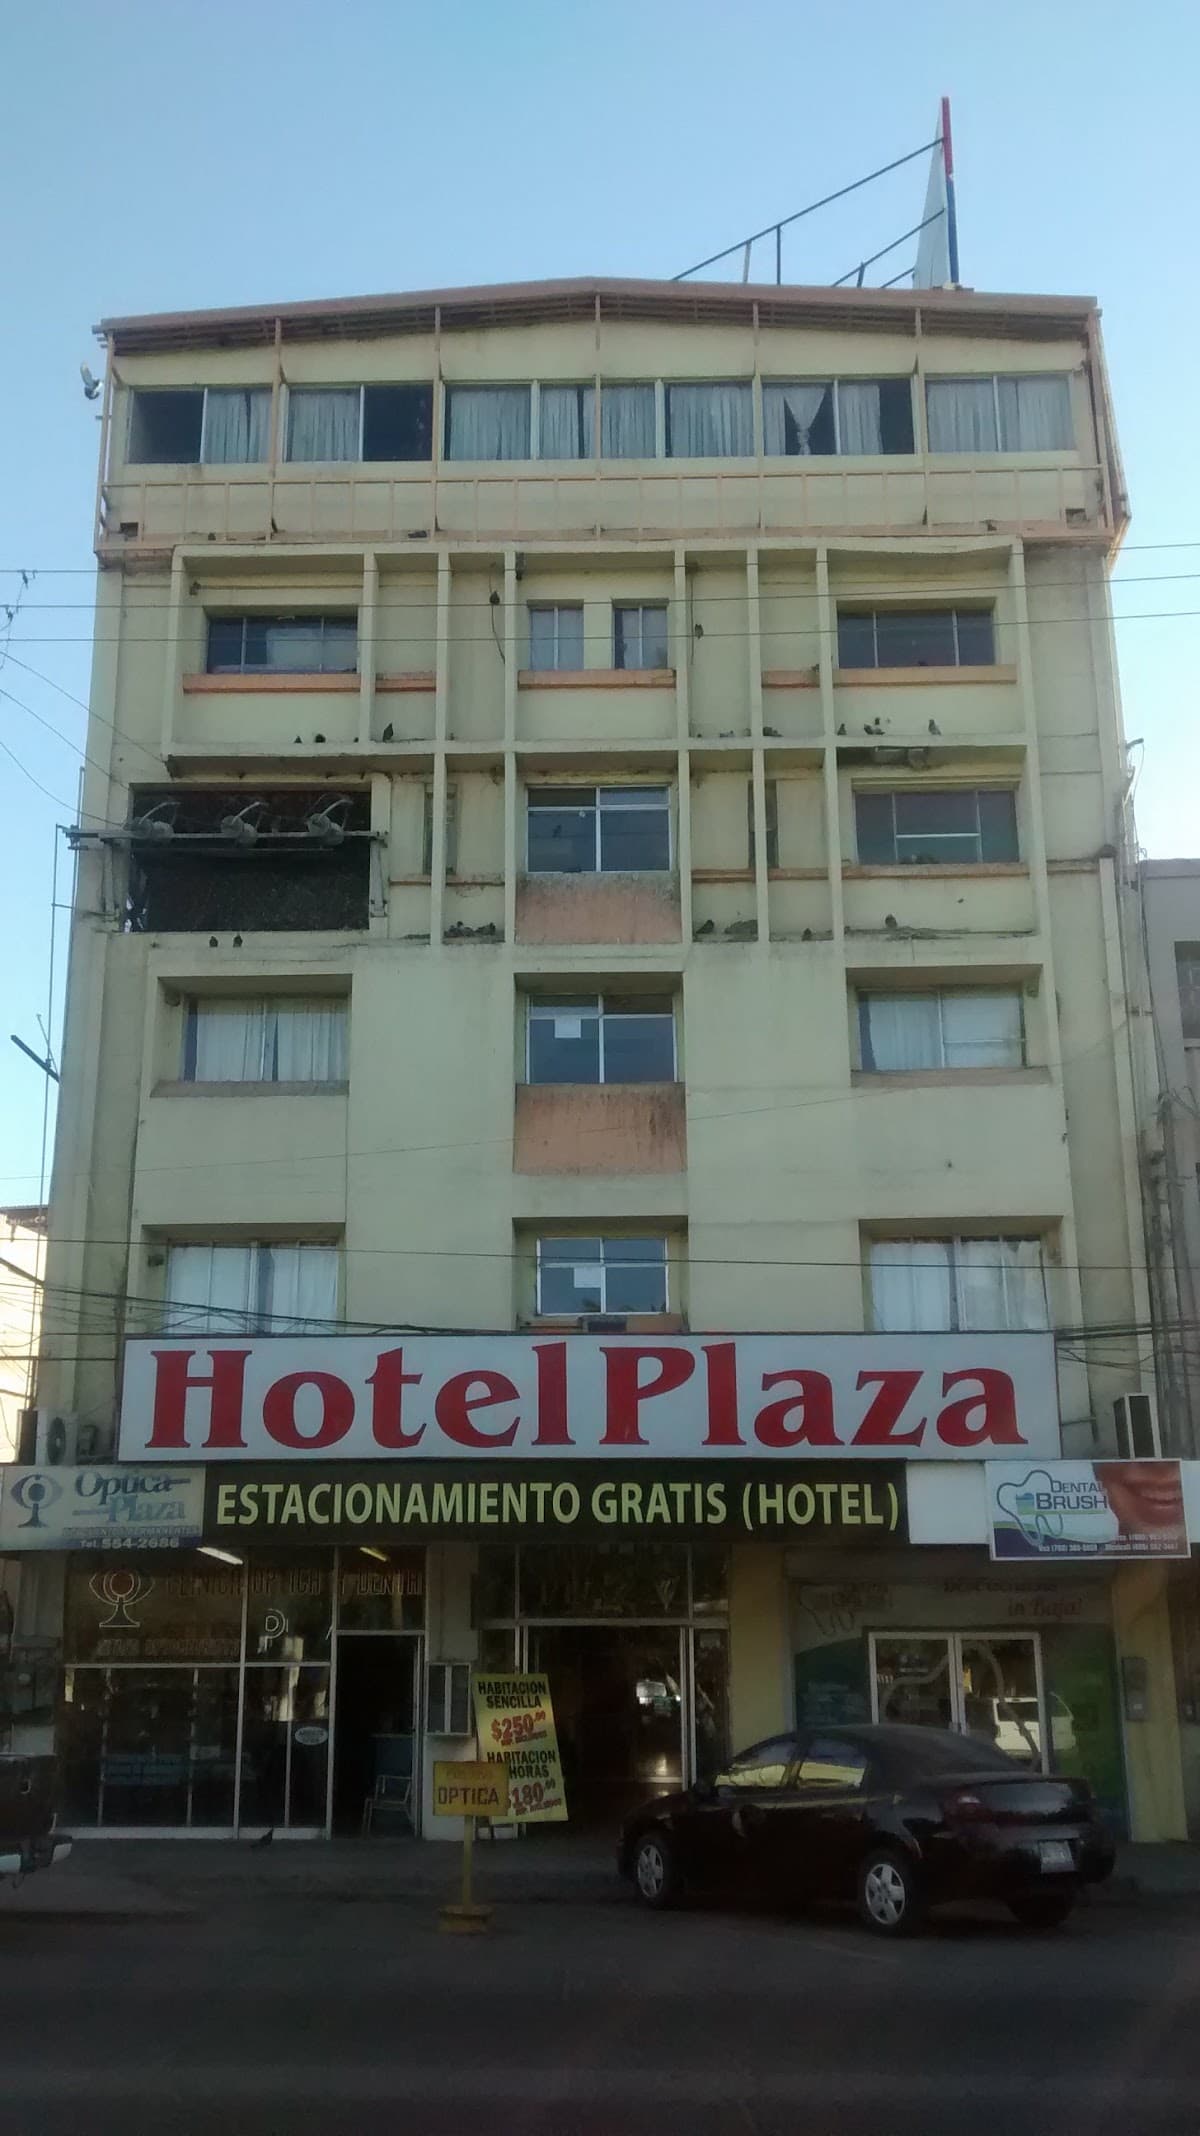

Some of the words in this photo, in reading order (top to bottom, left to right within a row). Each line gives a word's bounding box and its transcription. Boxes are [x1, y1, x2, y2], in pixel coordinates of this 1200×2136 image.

[145, 1342, 576, 1449] Hotel
[598, 1342, 1028, 1447] Plaza
[1051, 1480, 1107, 1494] DENTAL
[107, 1495, 186, 1522] Plaza
[217, 1482, 580, 1525] ESTACIONAMIENTO
[591, 1482, 728, 1525] GRATIS
[741, 1481, 899, 1531] (HOTEL)
[1035, 1492, 1108, 1510] BRUSH
[478, 1681, 547, 1695] HABITACION
[486, 1695, 542, 1709] SENCILLA
[487, 1749, 557, 1764] HABITACION
[509, 1764, 550, 1780] HORAS
[438, 1787, 499, 1805] OPTICA
